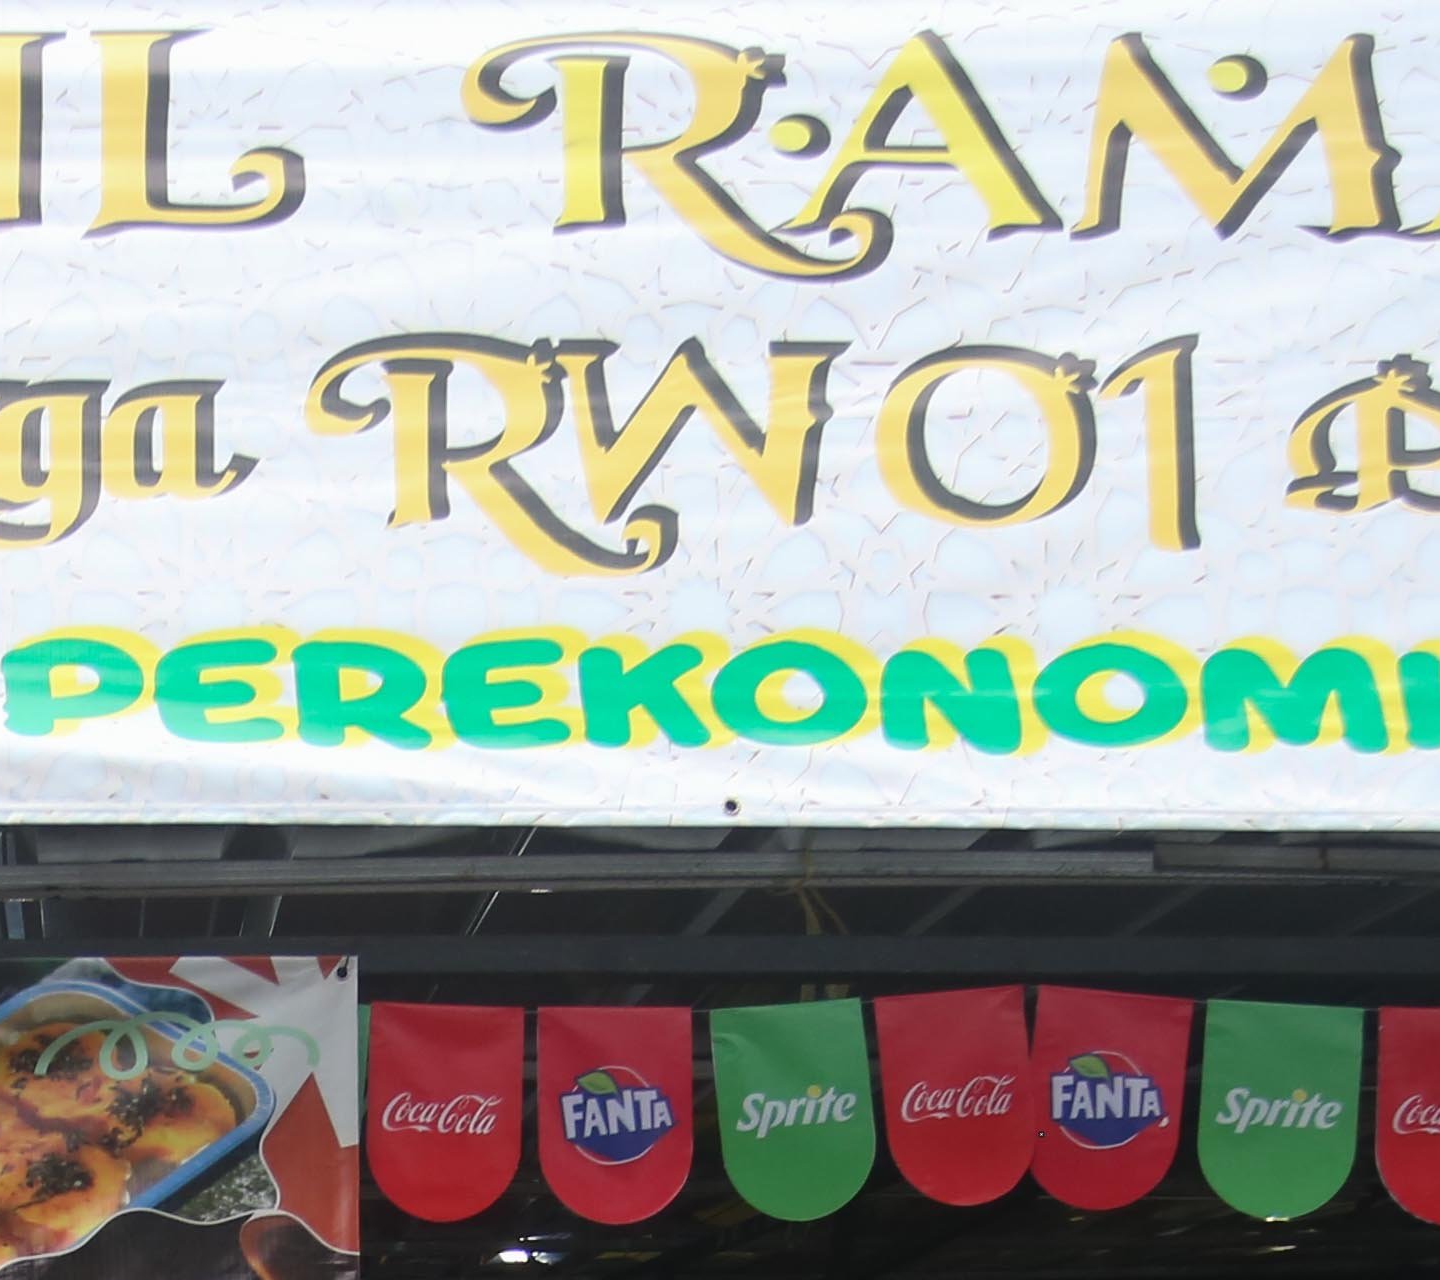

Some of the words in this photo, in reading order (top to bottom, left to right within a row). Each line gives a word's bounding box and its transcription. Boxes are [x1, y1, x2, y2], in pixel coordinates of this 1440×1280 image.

[561, 1087, 673, 1143] FANTA
[736, 1084, 857, 1140] Sprite
[1048, 1069, 1162, 1126] FANTA
[1215, 1087, 1342, 1137] Sprite
